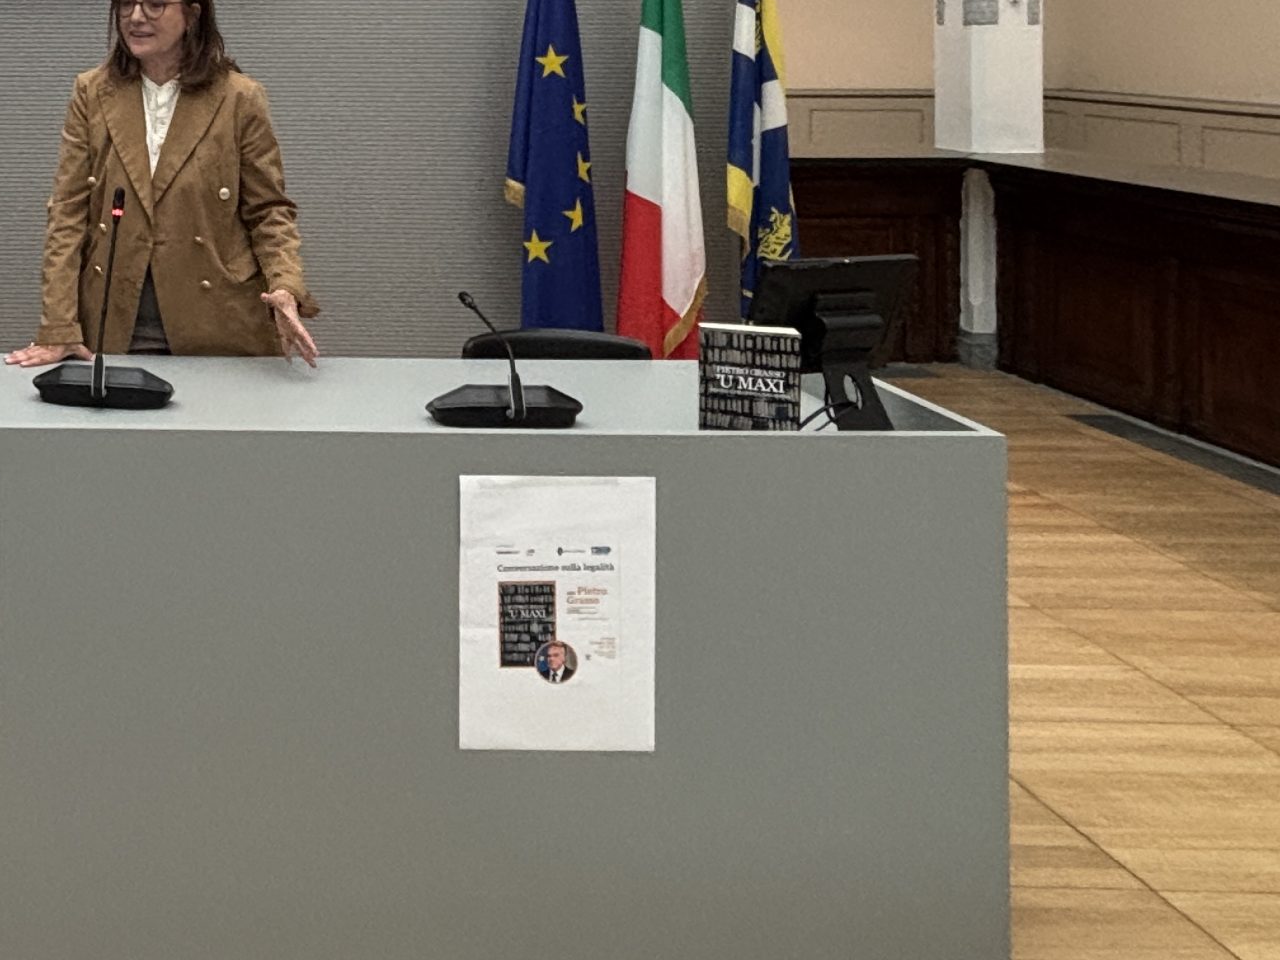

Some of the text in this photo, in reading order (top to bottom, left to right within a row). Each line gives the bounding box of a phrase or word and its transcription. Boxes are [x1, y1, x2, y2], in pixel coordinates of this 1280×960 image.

[716, 365, 786, 379] PIETRO GRASSO
[737, 376, 785, 394] MAXI
[521, 609, 547, 618] MAXI
